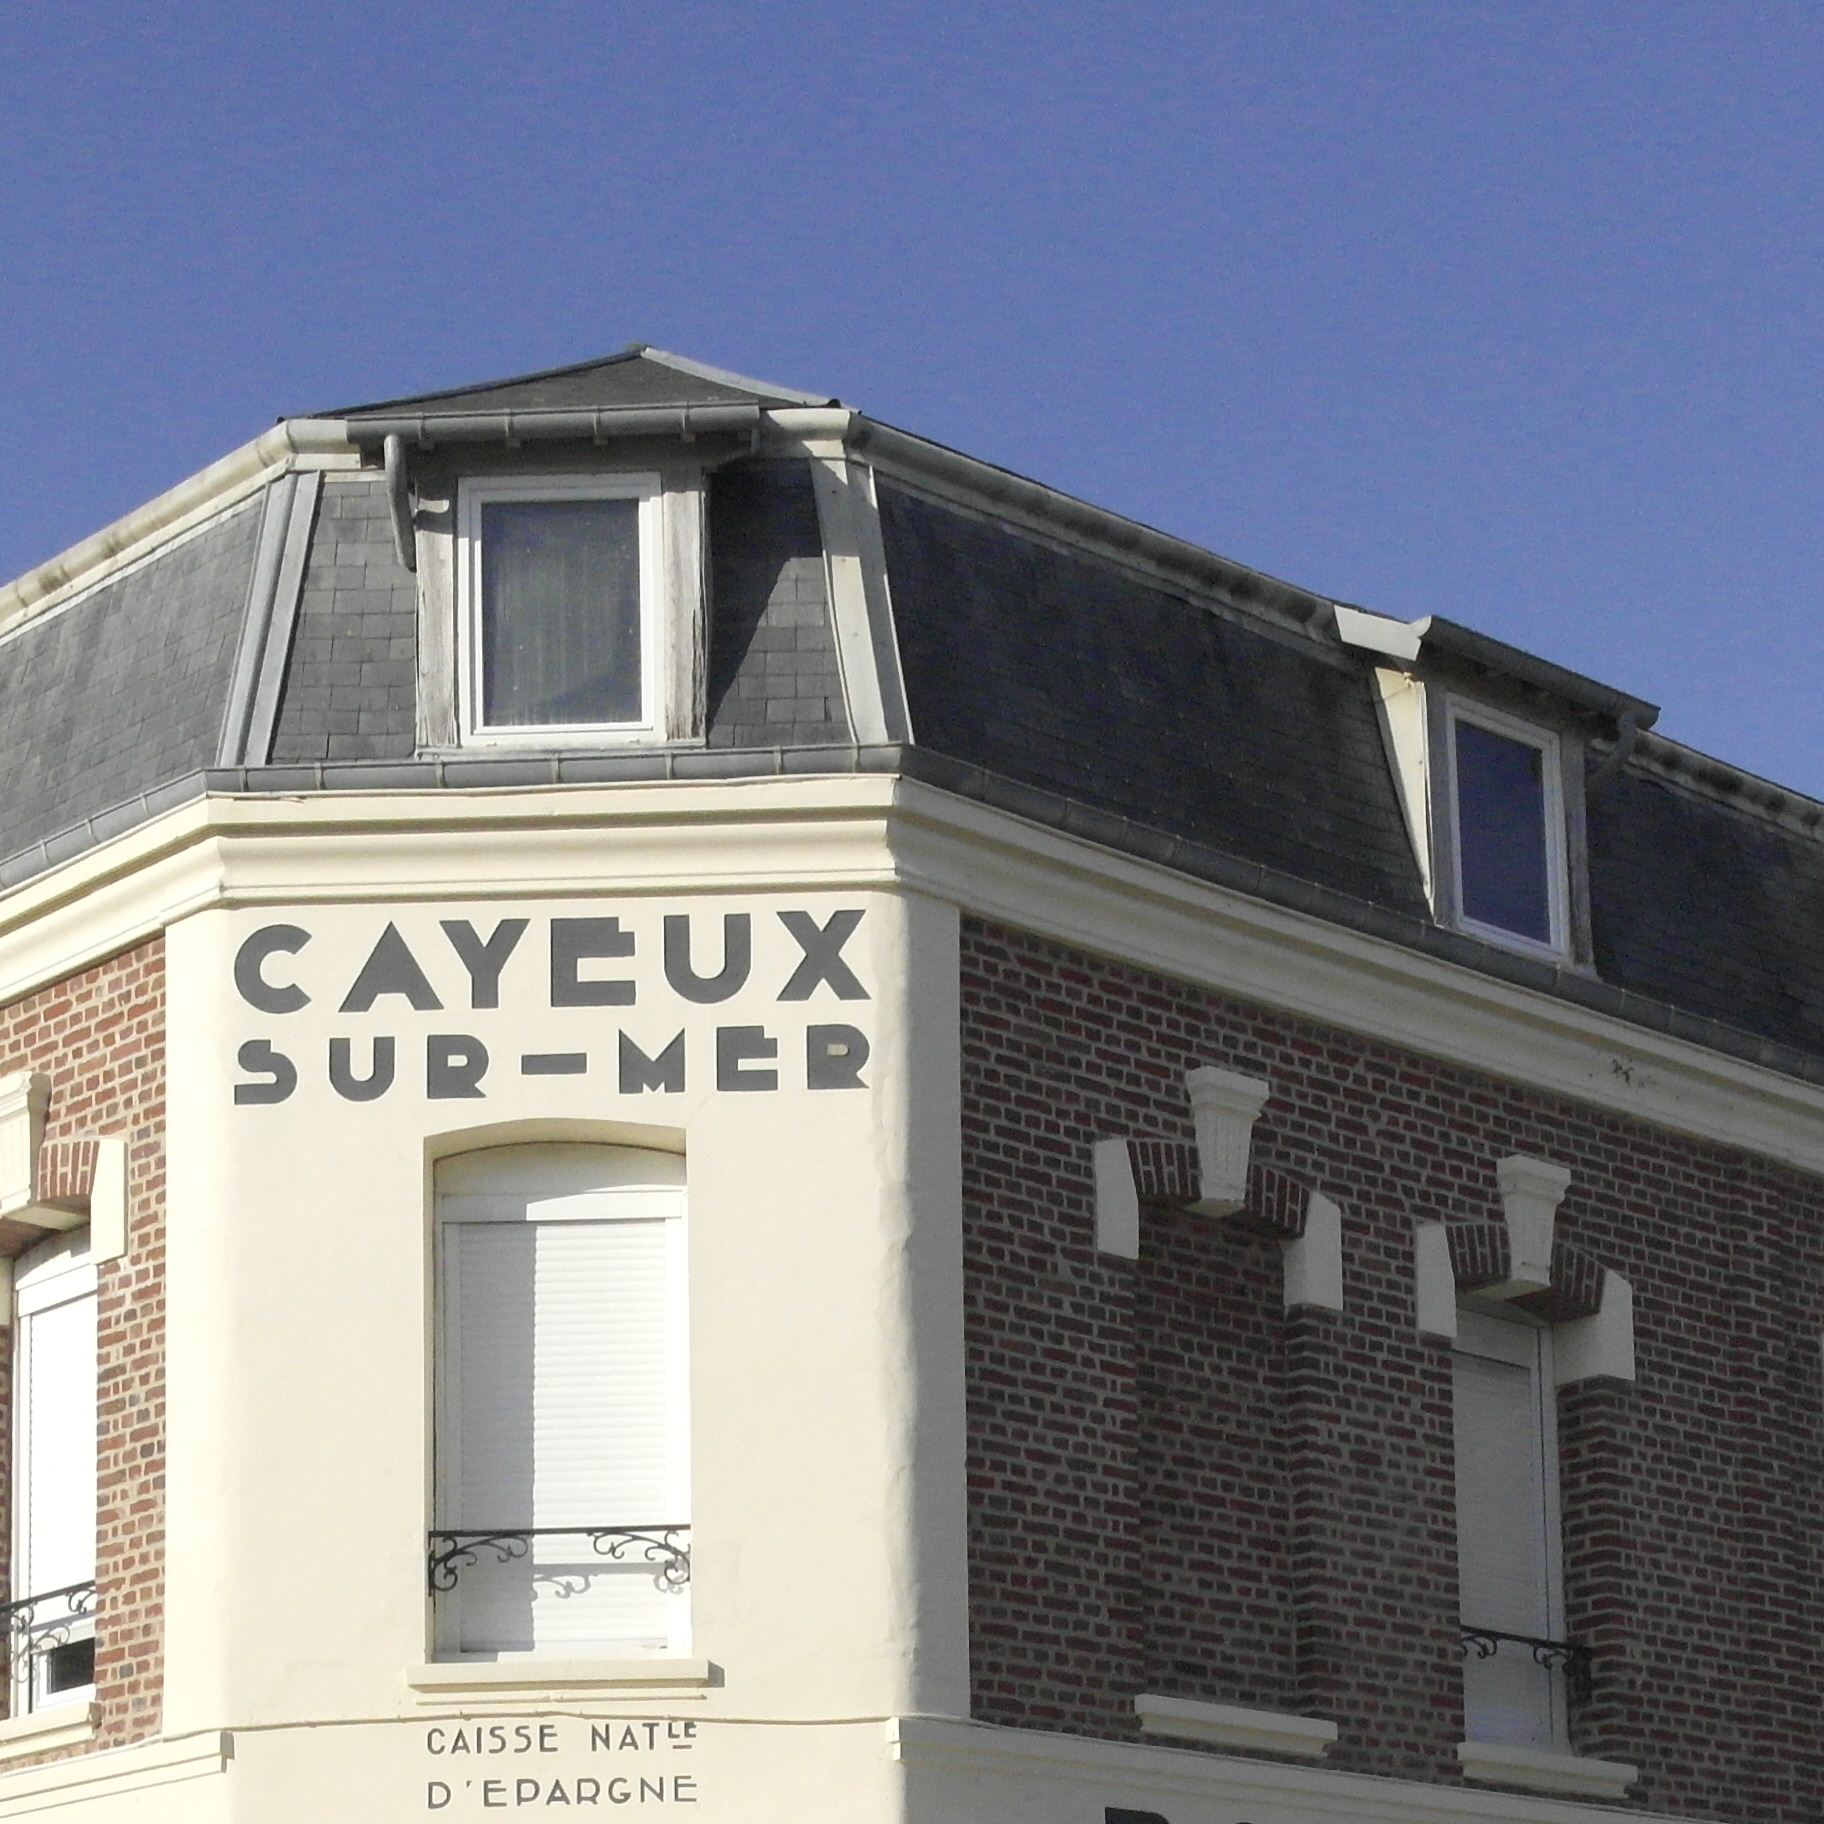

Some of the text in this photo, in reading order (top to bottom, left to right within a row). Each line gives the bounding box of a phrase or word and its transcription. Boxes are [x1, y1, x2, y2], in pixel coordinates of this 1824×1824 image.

[233, 909, 872, 1014] CAYEUX
[233, 1024, 871, 1106] SUR-MER
[426, 1724, 559, 1755] CAISSE
[427, 1775, 698, 1809] D'EPARGNE
